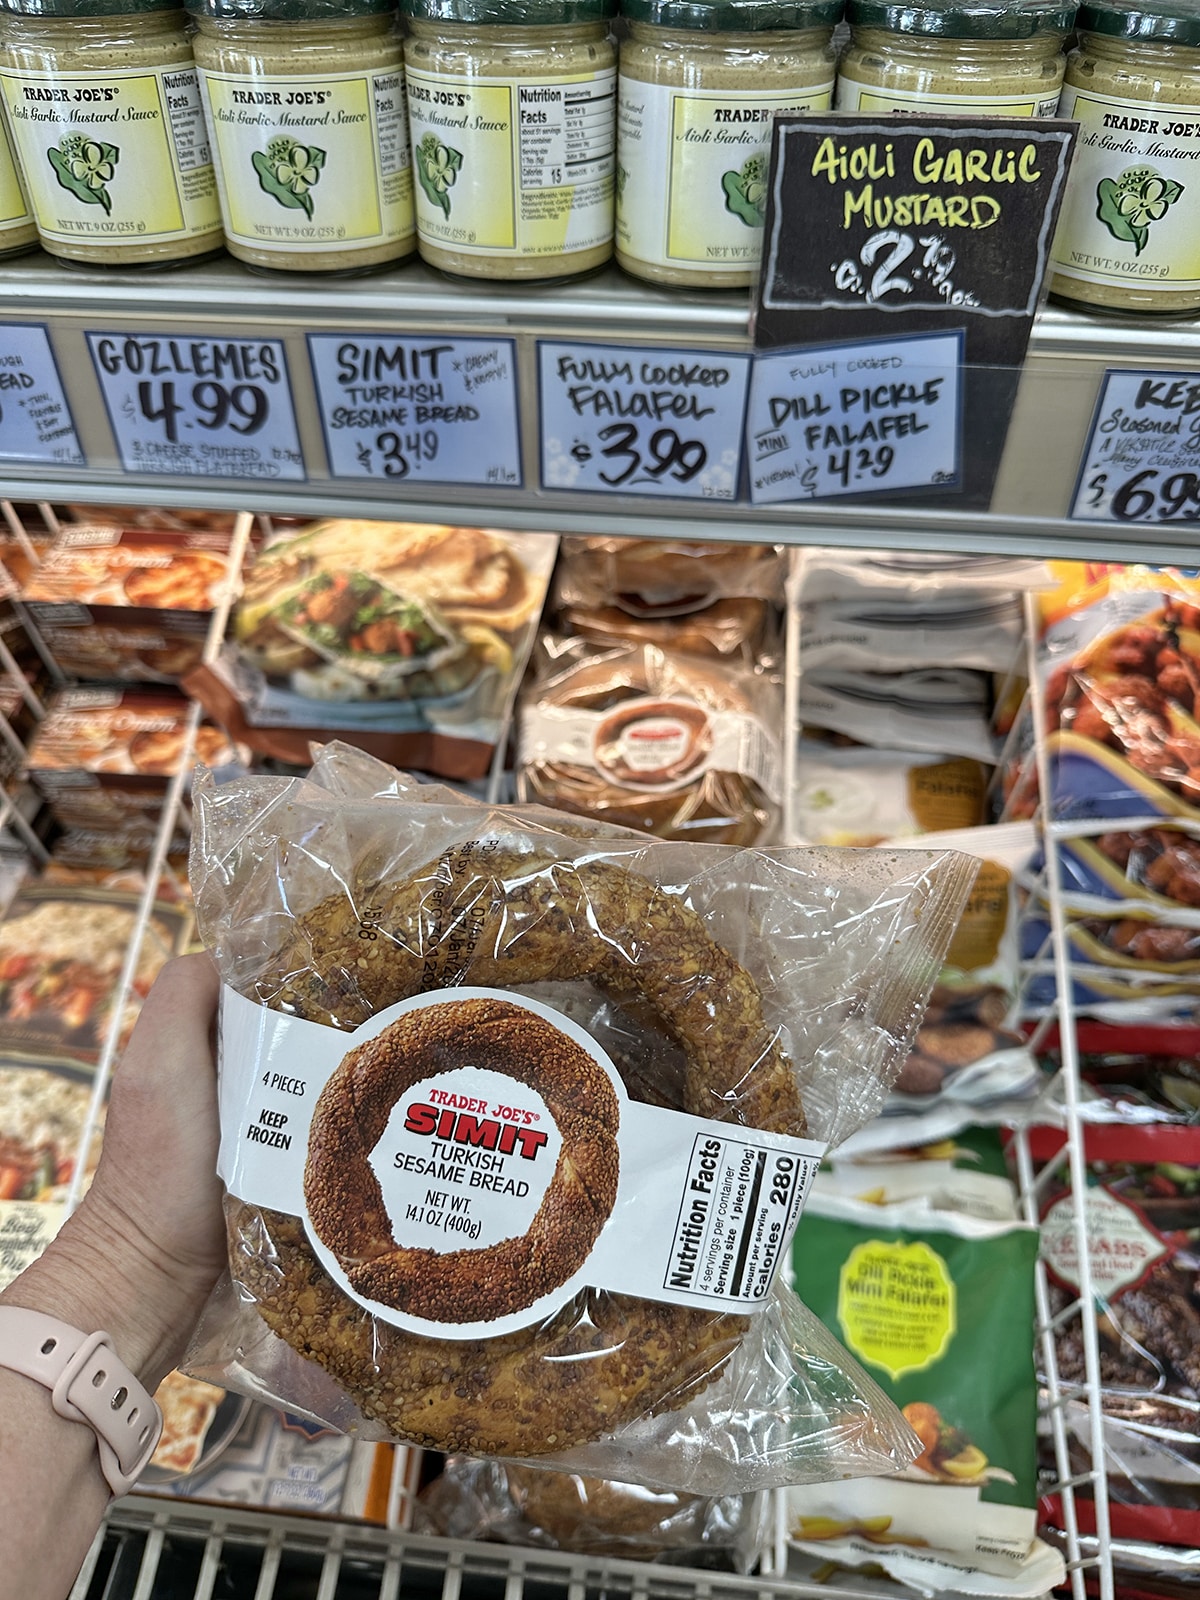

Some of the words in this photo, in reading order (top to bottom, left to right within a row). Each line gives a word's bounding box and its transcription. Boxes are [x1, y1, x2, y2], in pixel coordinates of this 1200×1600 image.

[163, 73, 195, 89] Nutrition
[23, 87, 71, 102] TRADER
[168, 94, 189, 110] Facts
[232, 90, 282, 105] TRADER
[520, 88, 561, 103] Nutrition
[31, 105, 62, 123] Garlic
[63, 108, 120, 124] Mustard
[122, 107, 159, 122] Sauce
[237, 109, 271, 126] Garlic
[272, 111, 329, 127] Mustard
[331, 110, 368, 126] Sauce
[424, 111, 469, 129] Mustard
[470, 116, 509, 131] Sauce
[521, 110, 547, 124] Facts
[714, 109, 769, 122] TRADER
[1103, 113, 1160, 135] TRADER
[676, 128, 712, 144] Aioli
[714, 129, 753, 144] Garlic
[1080, 131, 1096, 147] oli
[1098, 134, 1137, 155] Garlic
[843, 184, 1002, 230] MUSTARD
[706, 246, 732, 258] NET
[1069, 251, 1091, 266] NET
[1093, 255, 1112, 270] WT.
[1114, 261, 1120, 271] 9
[1121, 261, 1138, 273] OZ
[1139, 263, 1158, 276] (255
[337, 343, 455, 384] SIMIT
[558, 356, 634, 385] FULLY
[789, 361, 837, 381] FULLY
[846, 356, 903, 373] COOKED
[344, 383, 444, 406] TURKISH
[769, 394, 831, 429] DILL
[839, 377, 944, 414] PICKLE
[331, 405, 408, 429] SESAME
[415, 404, 480, 426] BREAD
[804, 412, 929, 451] FALAFEL
[262, 1070, 271, 1087] 4
[271, 1074, 307, 1096] PIECES
[429, 1088, 488, 1115] TRADER
[259, 1109, 289, 1130] KEEP
[404, 1102, 549, 1161] SIMIT
[247, 1124, 293, 1151] FROZEN
[431, 1141, 505, 1173] TURKISH
[738, 1148, 756, 1183] (100g)
[393, 1152, 466, 1184] SESAME
[469, 1171, 530, 1198] BREAD
[424, 1189, 449, 1209] NET
[451, 1195, 472, 1215] WT.
[718, 1166, 736, 1215] container
[732, 1183, 745, 1214] piece
[670, 1198, 709, 1288] Nutrition
[690, 1139, 722, 1194] Facts
[792, 1194, 803, 1219] Daily
[405, 1204, 425, 1223] 14.1
[426, 1209, 443, 1227] OZ
[444, 1212, 482, 1240] (400g)
[713, 1218, 725, 1236] per
[753, 1222, 782, 1298] Calories
[769, 1156, 794, 1207] 280
[755, 1208, 769, 1243] serving
[726, 1229, 737, 1251] size
[703, 1238, 721, 1282] servings
[753, 1245, 762, 1261] per
[714, 1254, 735, 1295] Serving
[743, 1261, 757, 1298] Amount
[699, 1284, 710, 1292] 4
